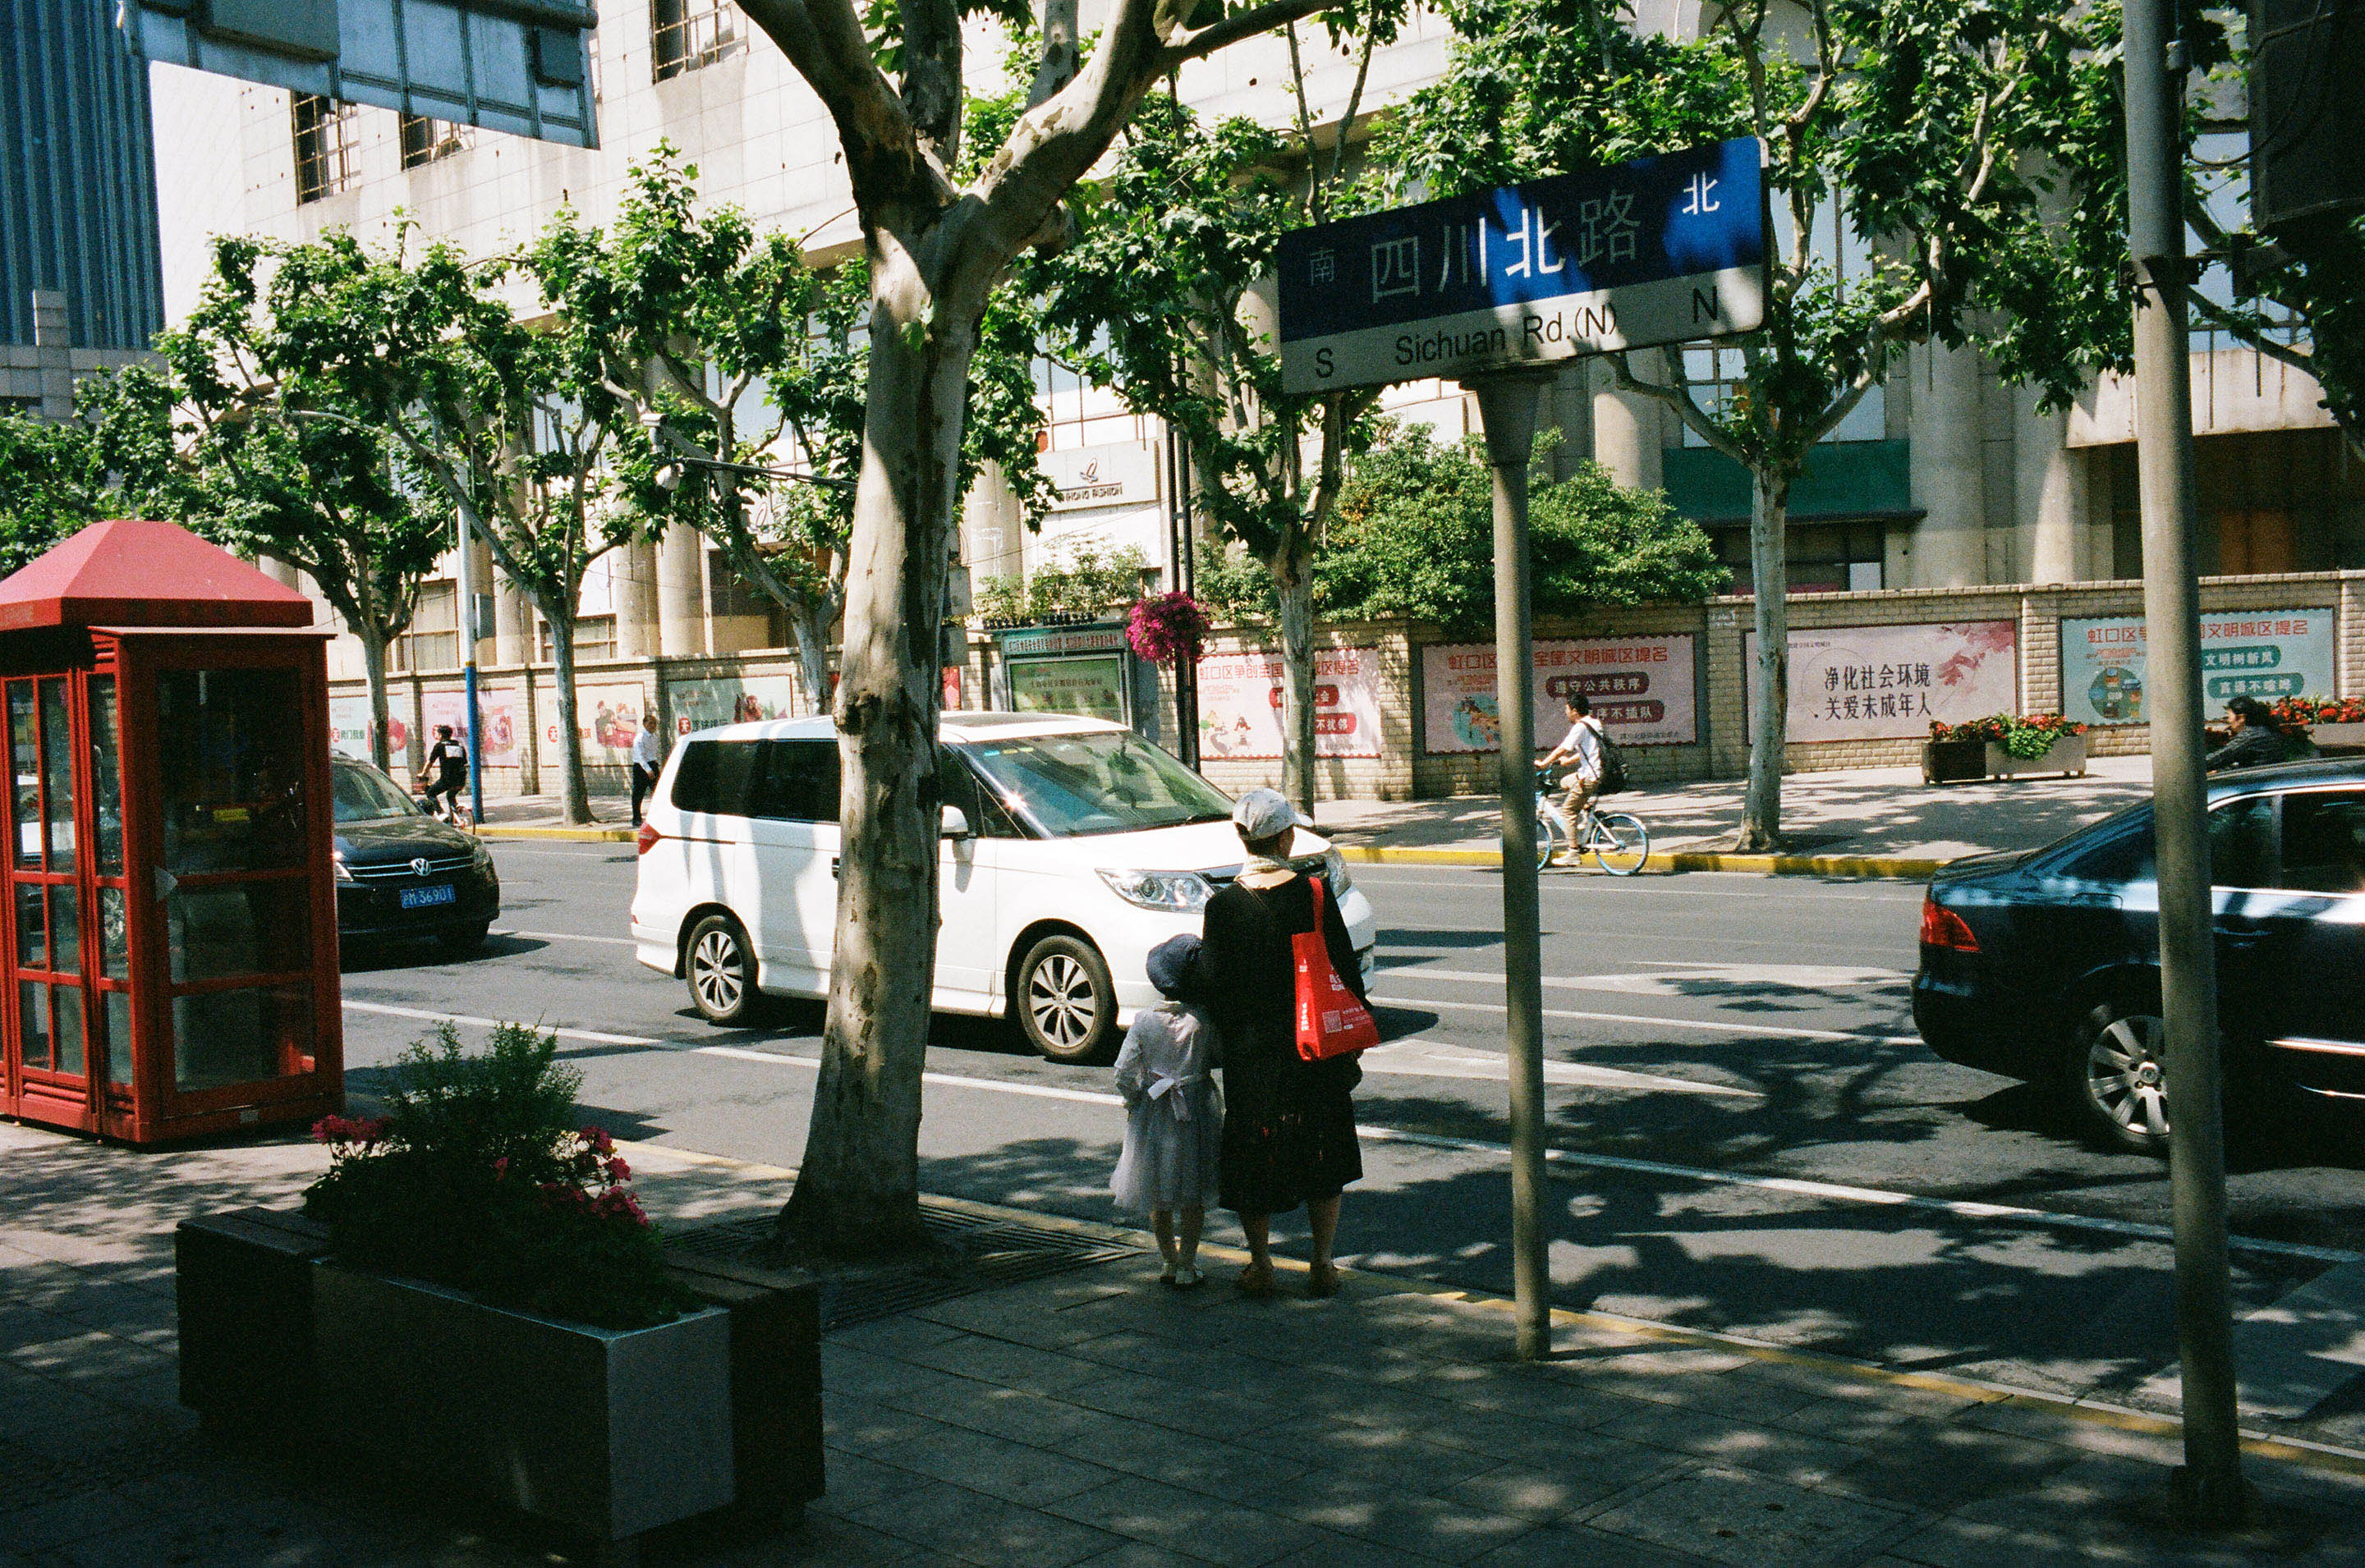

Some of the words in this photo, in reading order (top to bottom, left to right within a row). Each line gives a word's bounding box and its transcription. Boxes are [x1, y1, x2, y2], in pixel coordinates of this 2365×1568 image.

[1309, 247, 1337, 287] 南
[1371, 189, 1642, 304] 四川北路
[1682, 171, 1720, 216] 北
[1315, 347, 1334, 378] S
[1396, 327, 1506, 366] Sichuan
[1692, 285, 1719, 324] N
[1447, 646, 1668, 670] 虹口区全国文明城区提名
[2204, 651, 2273, 667] 文明树新风
[1823, 663, 1931, 692] 净化社会环境
[1589, 705, 1652, 723] 序不插队
[1824, 692, 1932, 722] 关爱未成年人
